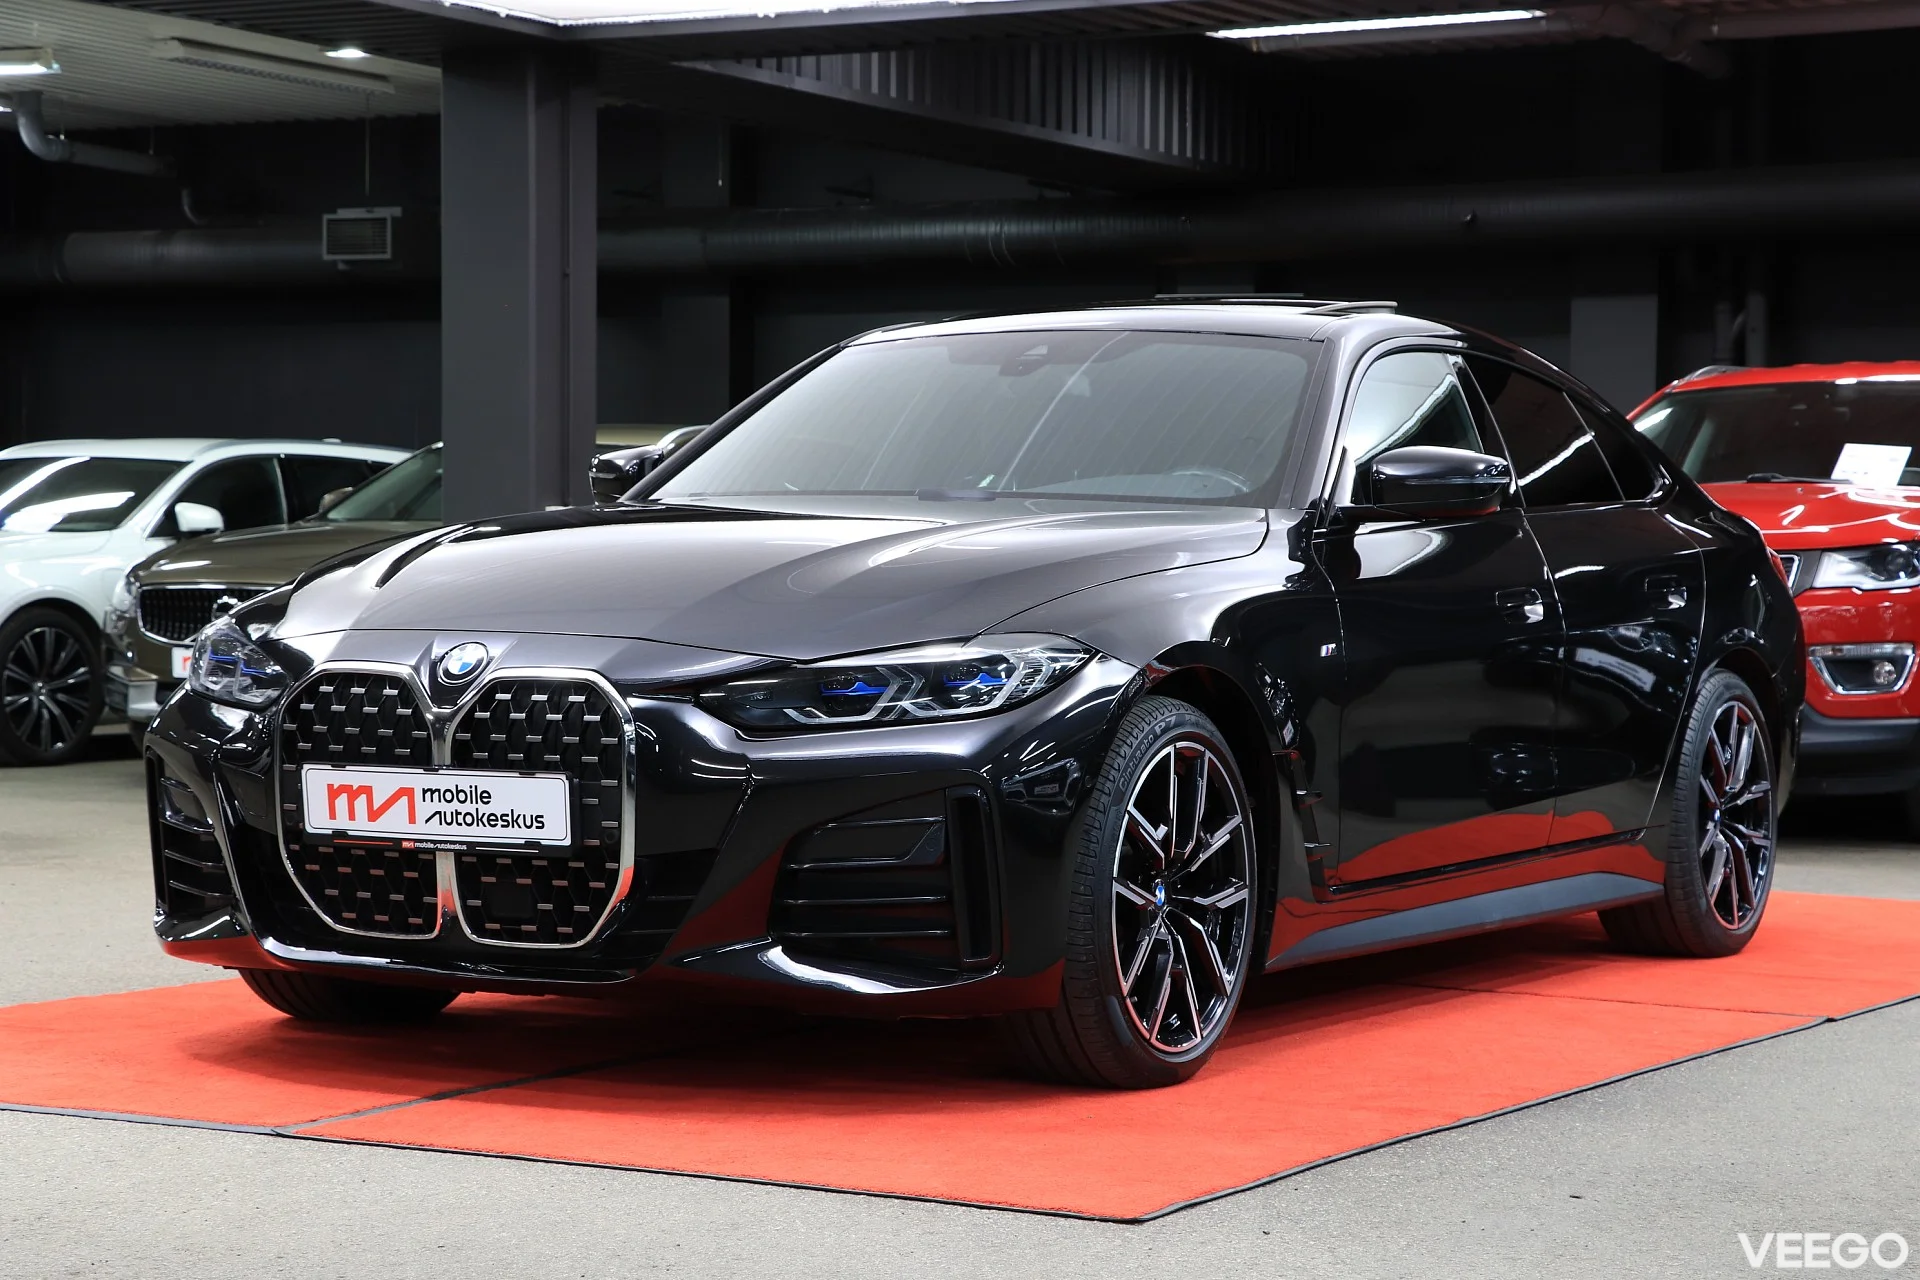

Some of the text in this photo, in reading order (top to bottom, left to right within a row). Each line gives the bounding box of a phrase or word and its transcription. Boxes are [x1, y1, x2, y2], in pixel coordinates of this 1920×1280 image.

[1120, 715, 1176, 792] Cinturato P7
[422, 784, 492, 805] mobile
[425, 808, 545, 830] Autokeskus
